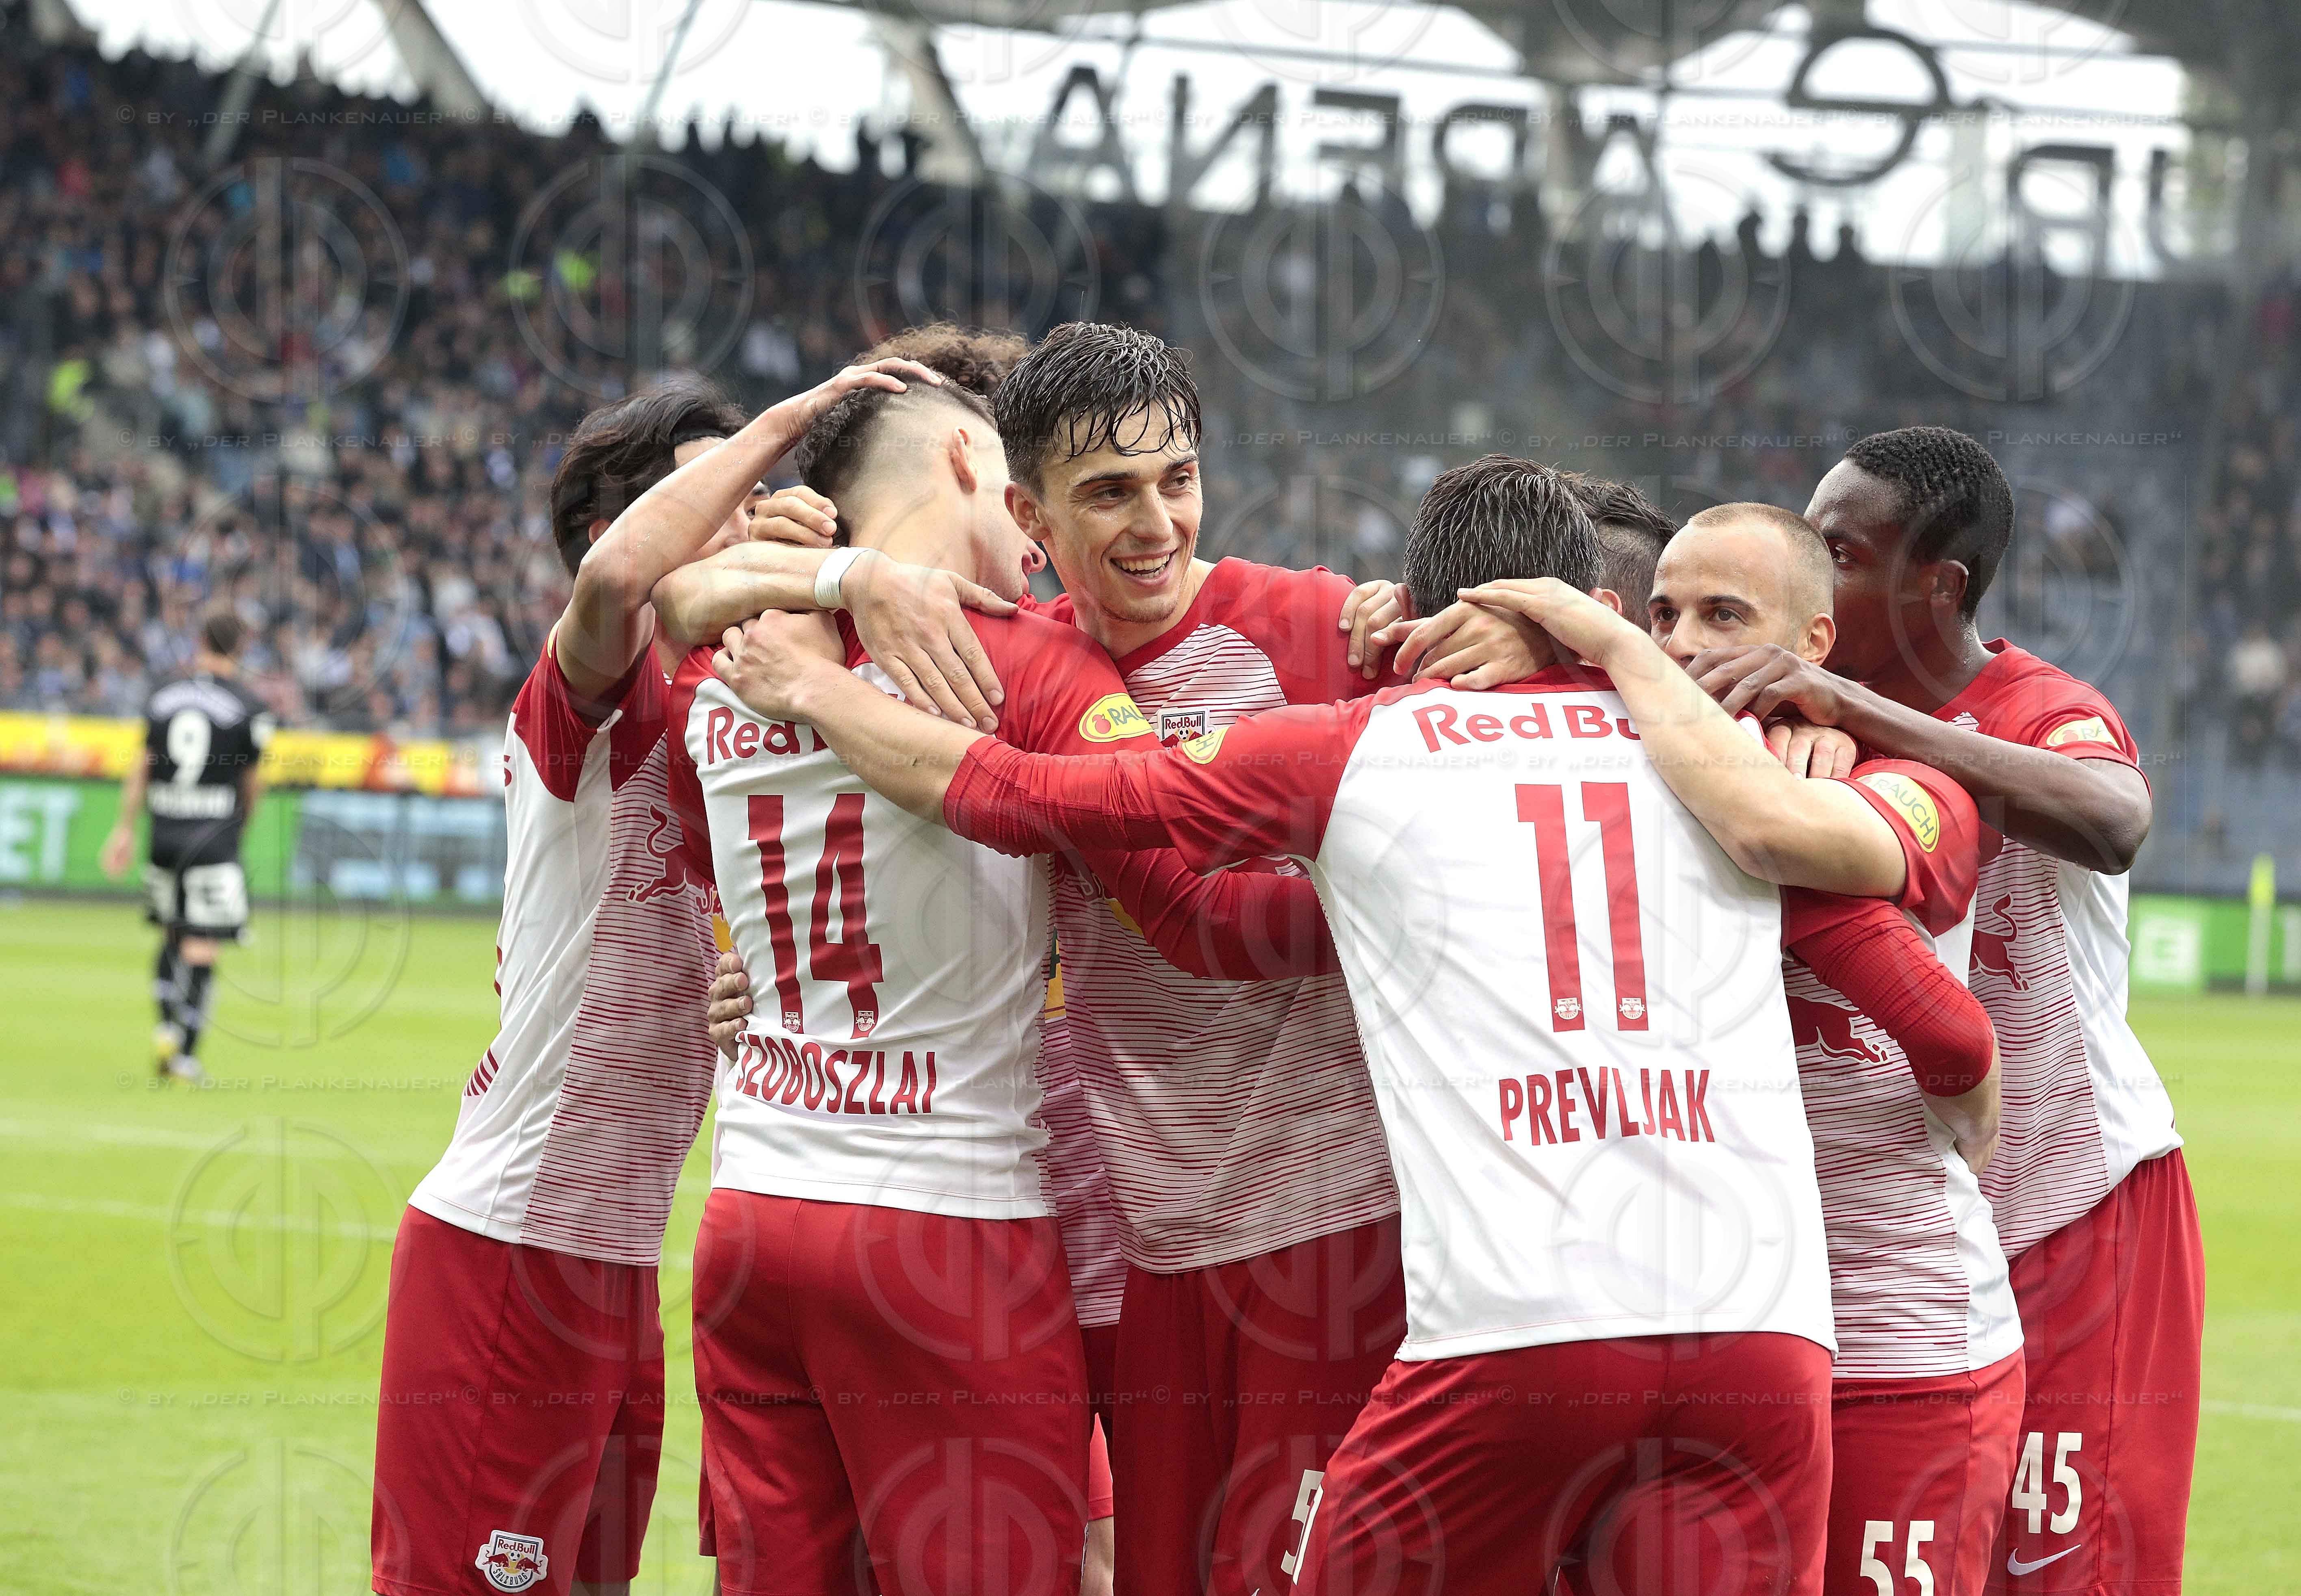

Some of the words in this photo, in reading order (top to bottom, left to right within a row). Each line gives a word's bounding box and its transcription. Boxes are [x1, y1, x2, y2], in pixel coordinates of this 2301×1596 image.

[167, 708, 212, 785] 9
[706, 706, 801, 764] Red
[1107, 705, 1146, 726] RAU
[1412, 703, 1553, 753] Red
[1873, 779, 1934, 838] RAUCH
[748, 793, 884, 1039] 14
[1515, 782, 1649, 1032] 11
[736, 1032, 936, 1115] SZOBOSZLAI
[1499, 1066, 1715, 1146] PREVLJAK
[2012, 1431, 2082, 1534] 45
[493, 1568, 528, 1585] SALZBURG
[1860, 1520, 1935, 1596] 55
